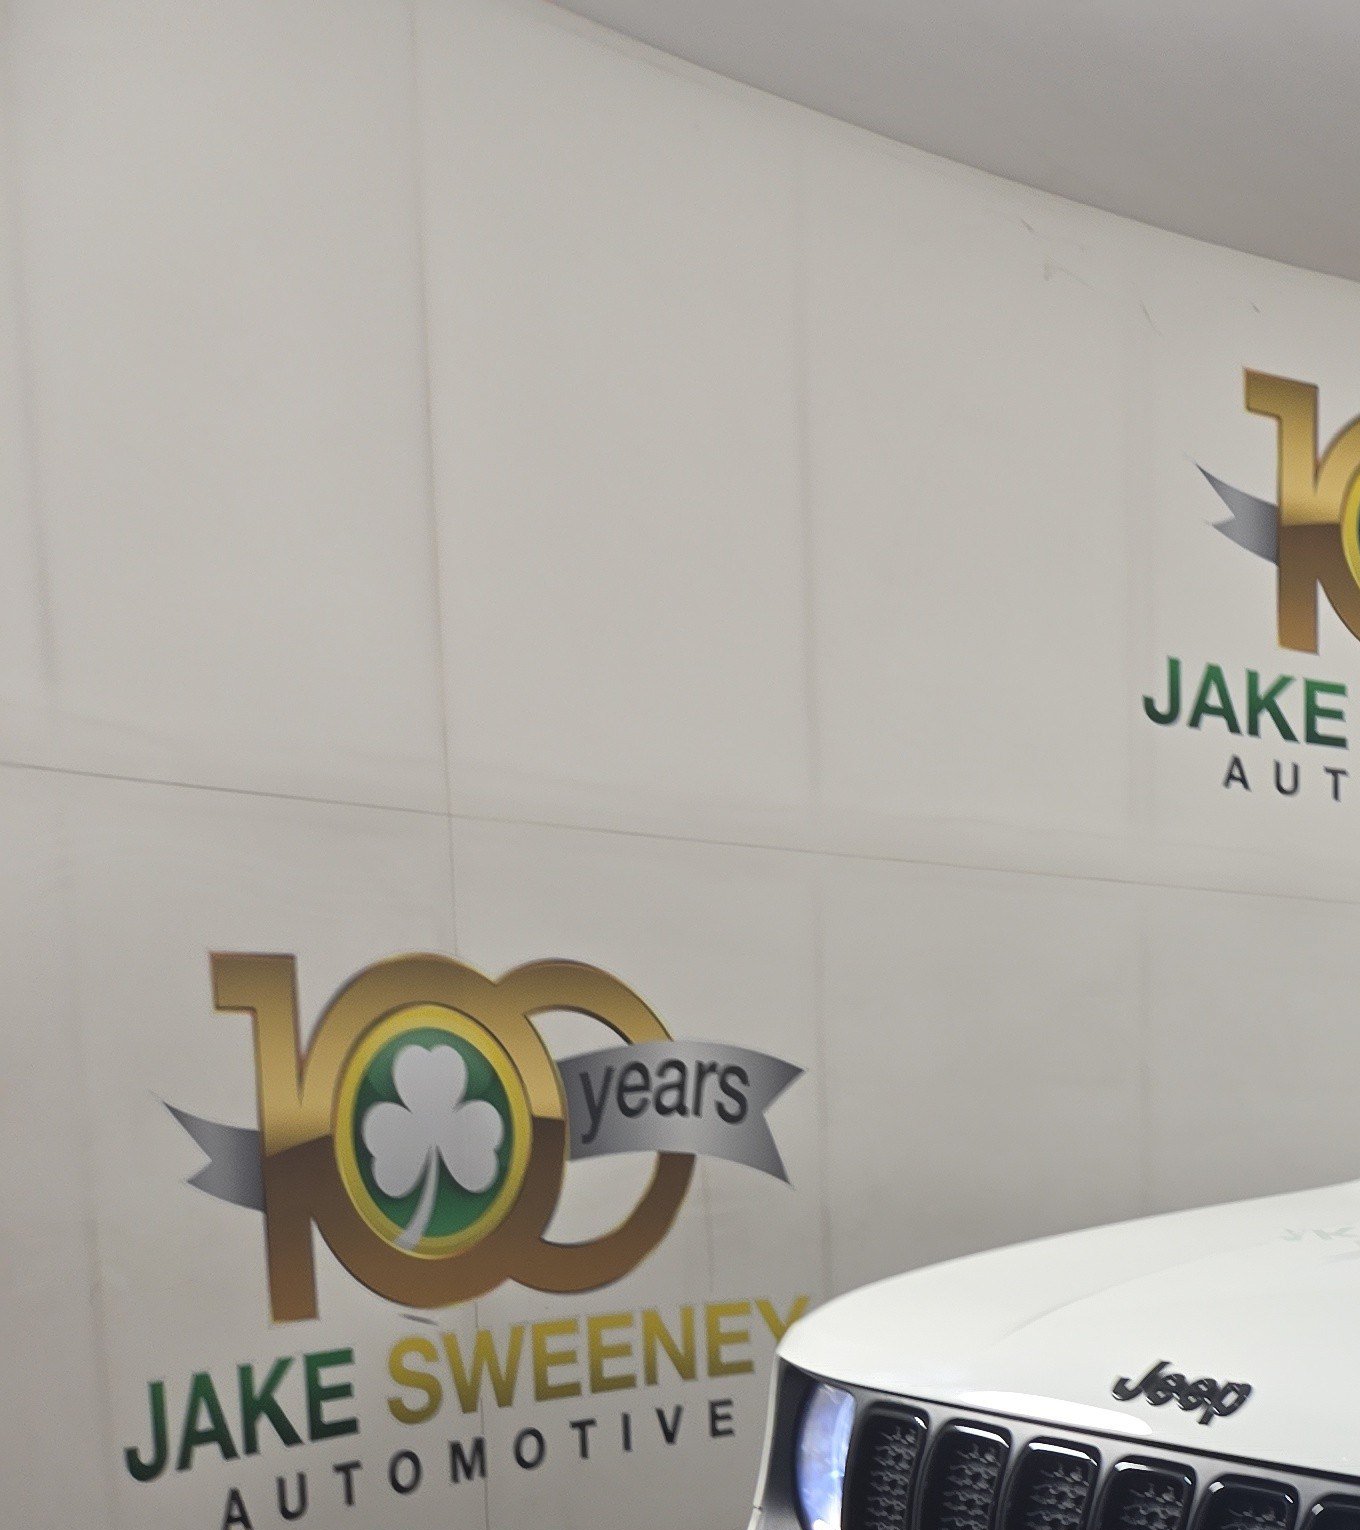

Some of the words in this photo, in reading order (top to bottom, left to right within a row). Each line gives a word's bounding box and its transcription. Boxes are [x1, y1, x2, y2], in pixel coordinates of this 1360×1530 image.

[1141, 656, 1349, 750] JAKE
[209, 951, 696, 1323] 100
[579, 1056, 751, 1143] years
[123, 1347, 359, 1482] JAKE
[386, 1295, 809, 1425] SWEENEY
[1112, 1359, 1252, 1426] Jeep
